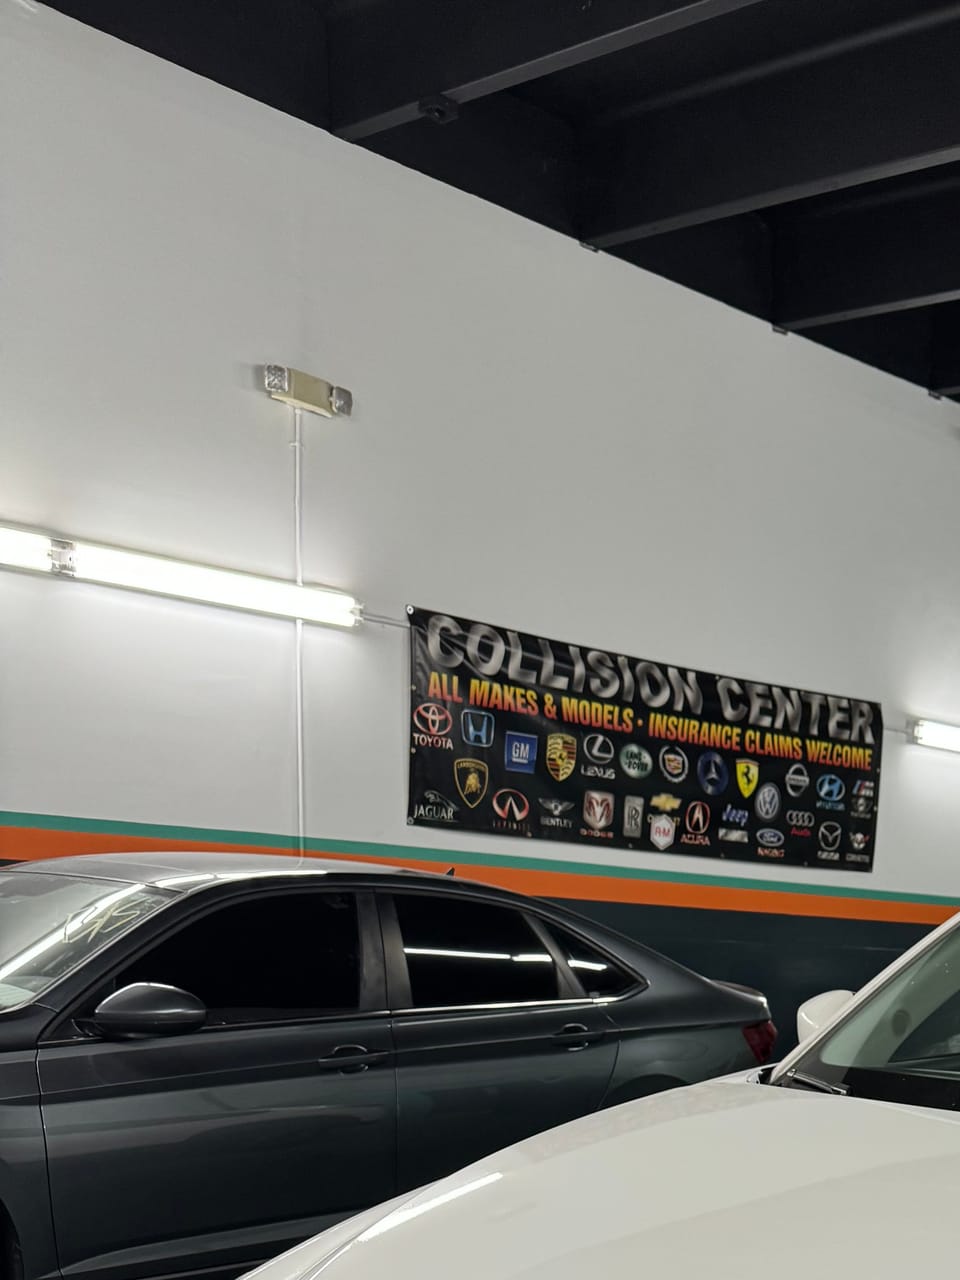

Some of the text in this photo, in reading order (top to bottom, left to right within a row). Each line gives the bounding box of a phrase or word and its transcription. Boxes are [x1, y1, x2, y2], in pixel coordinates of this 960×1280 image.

[427, 614, 875, 744] COLLISION CENTER
[428, 671, 873, 771] ALL MAKES & MODELS INSURANCE CLAIMS WELCOME
[412, 732, 454, 751] TOYOTA
[511, 742, 529, 760] GM
[580, 764, 616, 780] LEXUS
[413, 804, 454, 820] JAGUAR
[722, 804, 749, 827] Jeep
[680, 834, 711, 847] ACURA
